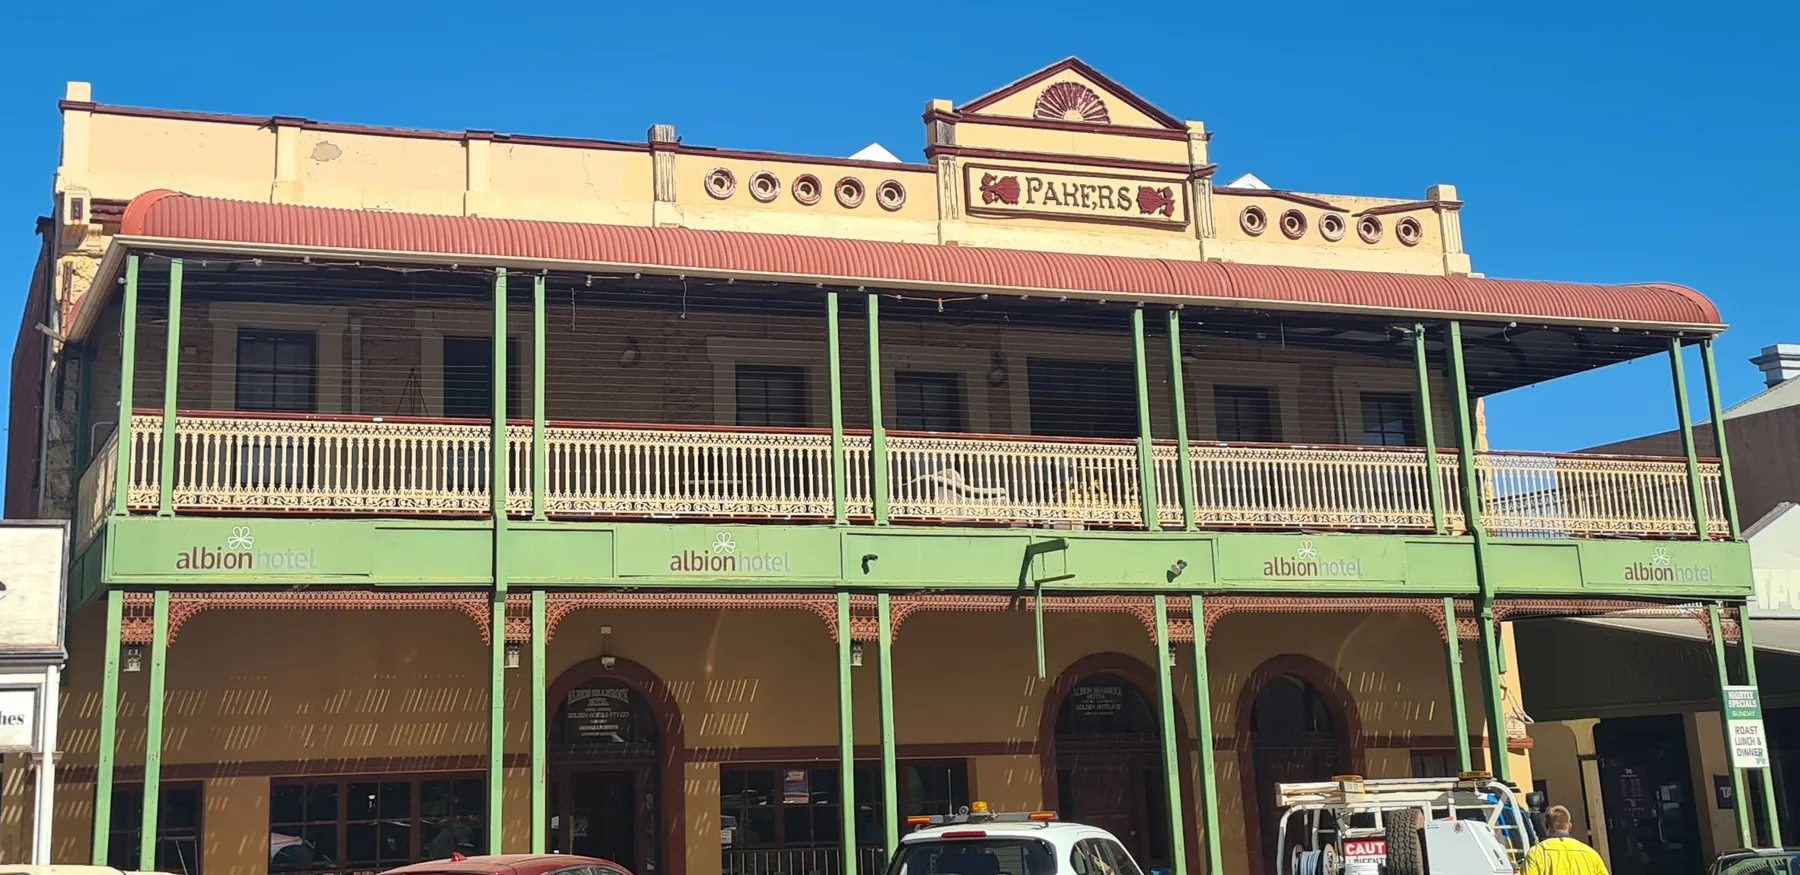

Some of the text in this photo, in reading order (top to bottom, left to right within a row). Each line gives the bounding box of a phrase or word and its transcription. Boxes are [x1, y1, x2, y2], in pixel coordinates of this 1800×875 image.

[1728, 699, 1757, 708] SPECIALS
[1734, 726, 1758, 734] ROAST
[1734, 737, 1762, 746] LUNCH &
[1736, 748, 1763, 756] DINNER
